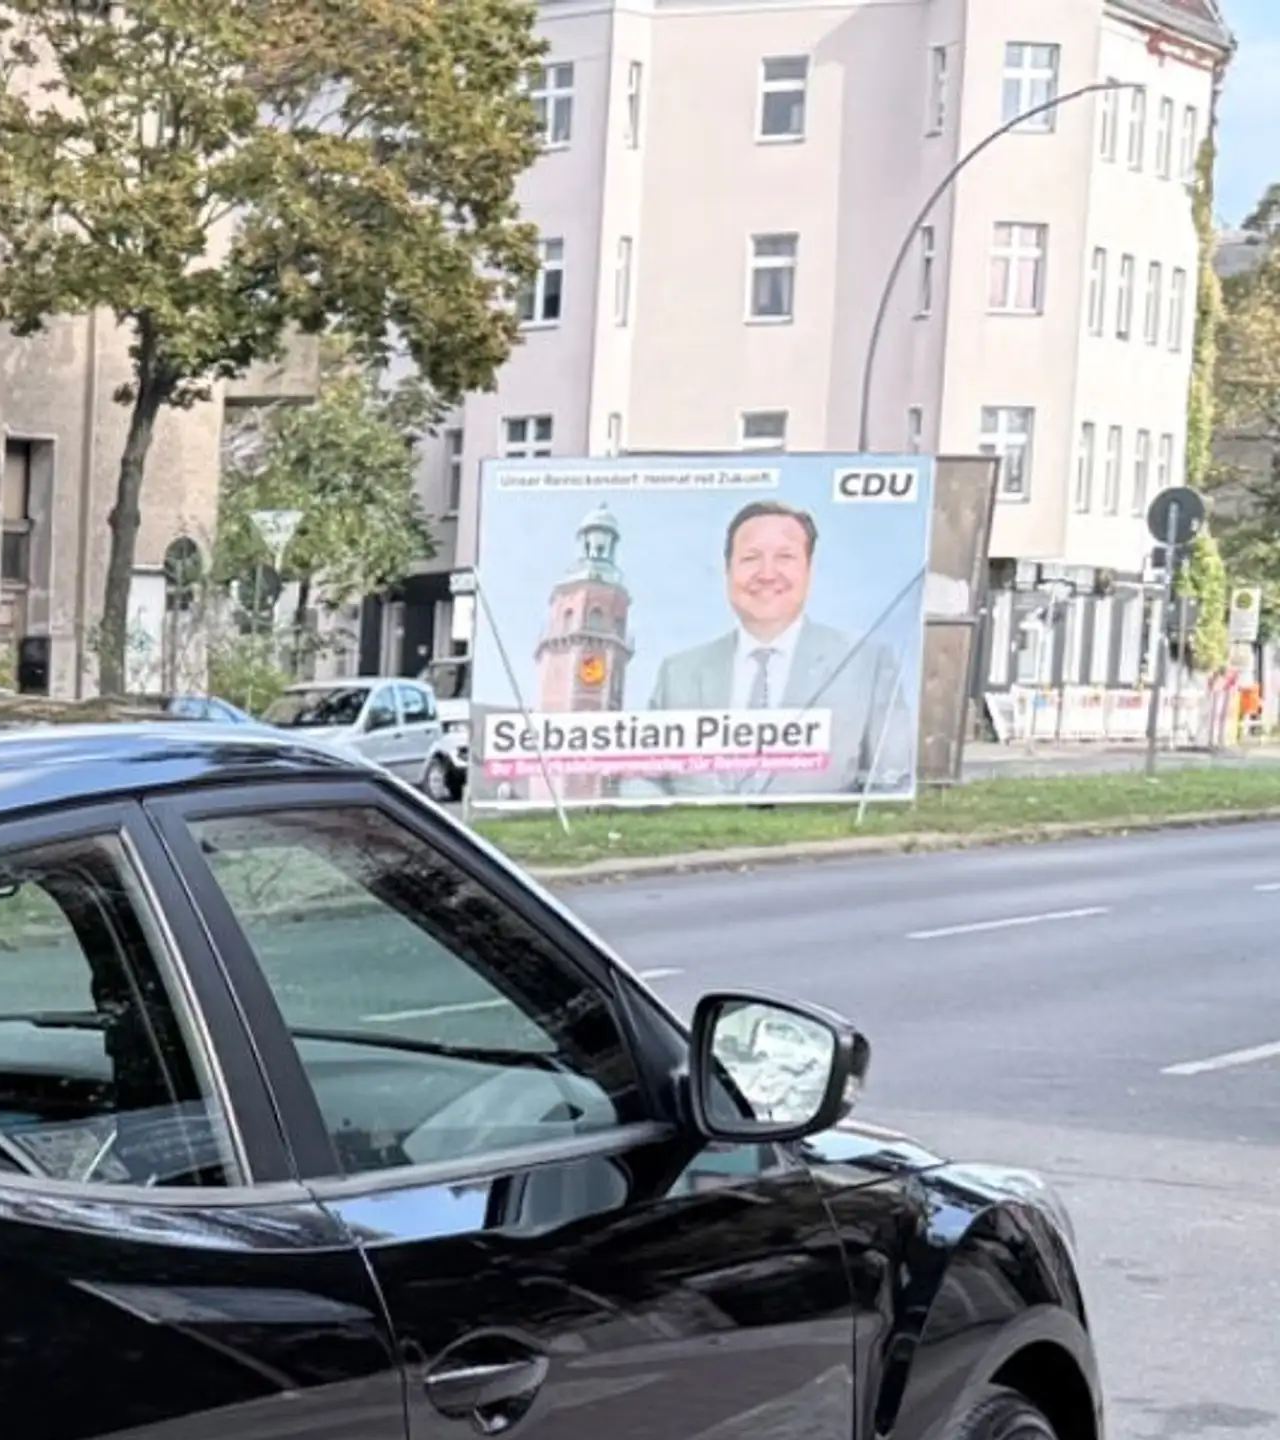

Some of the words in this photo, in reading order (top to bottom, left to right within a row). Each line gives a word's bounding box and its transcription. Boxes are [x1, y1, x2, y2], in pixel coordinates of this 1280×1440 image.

[838, 472, 914, 498] CDU
[493, 715, 685, 753] Sebastian
[697, 714, 821, 757] Pieper
